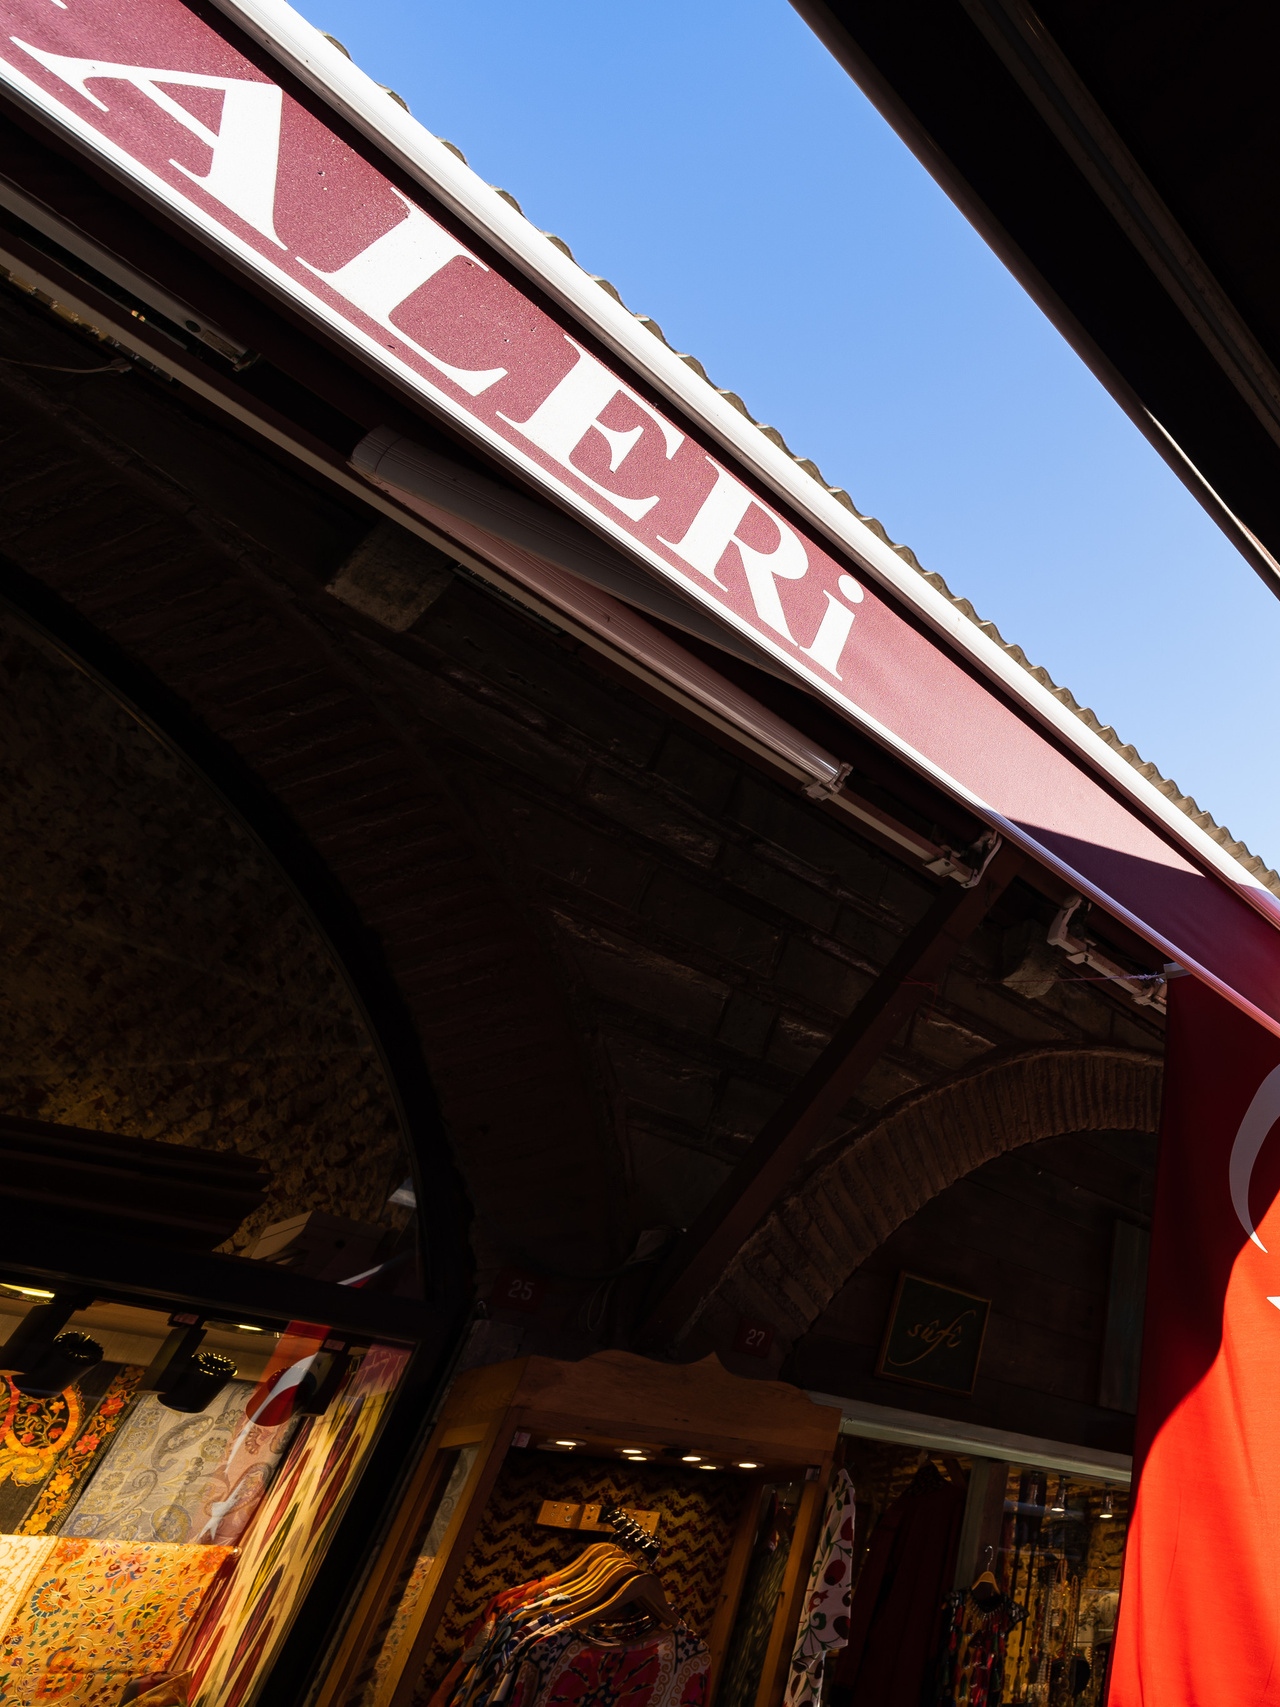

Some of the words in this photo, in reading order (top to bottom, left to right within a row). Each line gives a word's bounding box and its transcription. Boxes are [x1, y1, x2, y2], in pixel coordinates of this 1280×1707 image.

[9, 0, 865, 682] ALERi
[507, 1279, 535, 1302] 25
[744, 1328, 767, 1348] 27
